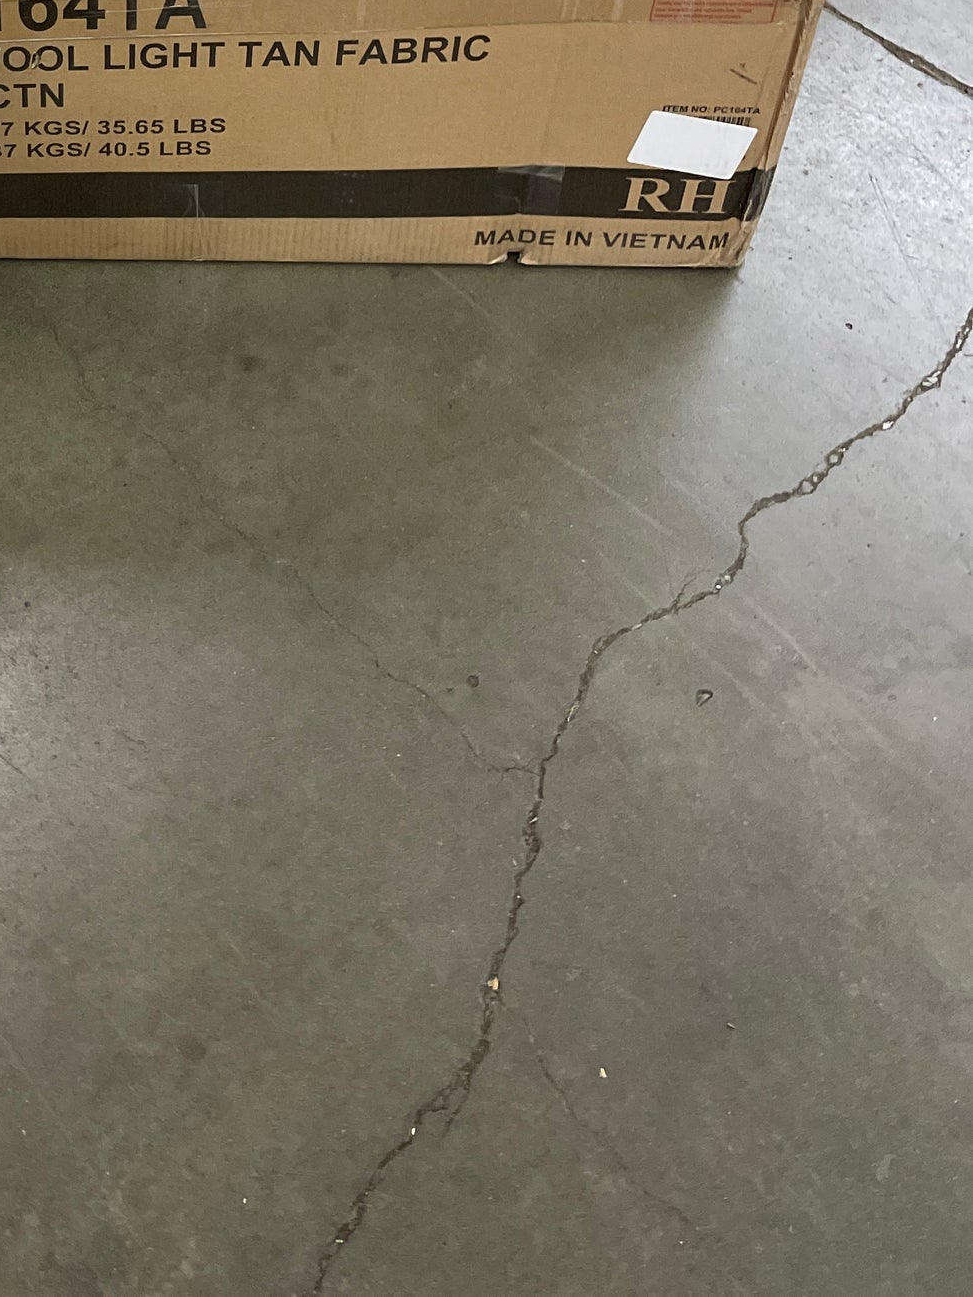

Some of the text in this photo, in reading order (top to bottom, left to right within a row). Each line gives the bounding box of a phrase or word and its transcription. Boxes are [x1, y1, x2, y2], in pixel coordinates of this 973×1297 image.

[103, 40, 224, 72] LIGHT
[238, 40, 321, 69] TAN
[335, 34, 493, 66] FABRIC
[662, 105, 689, 113] ITEM
[24, 120, 90, 137] KGS/
[97, 119, 164, 136] 35.65
[173, 118, 227, 134] LBS
[26, 142, 91, 159] KGS/
[98, 141, 151, 157] 40.5
[159, 140, 212, 157] LBS
[618, 177, 736, 214] RH
[474, 229, 730, 250] MADE IN VIETNAM
